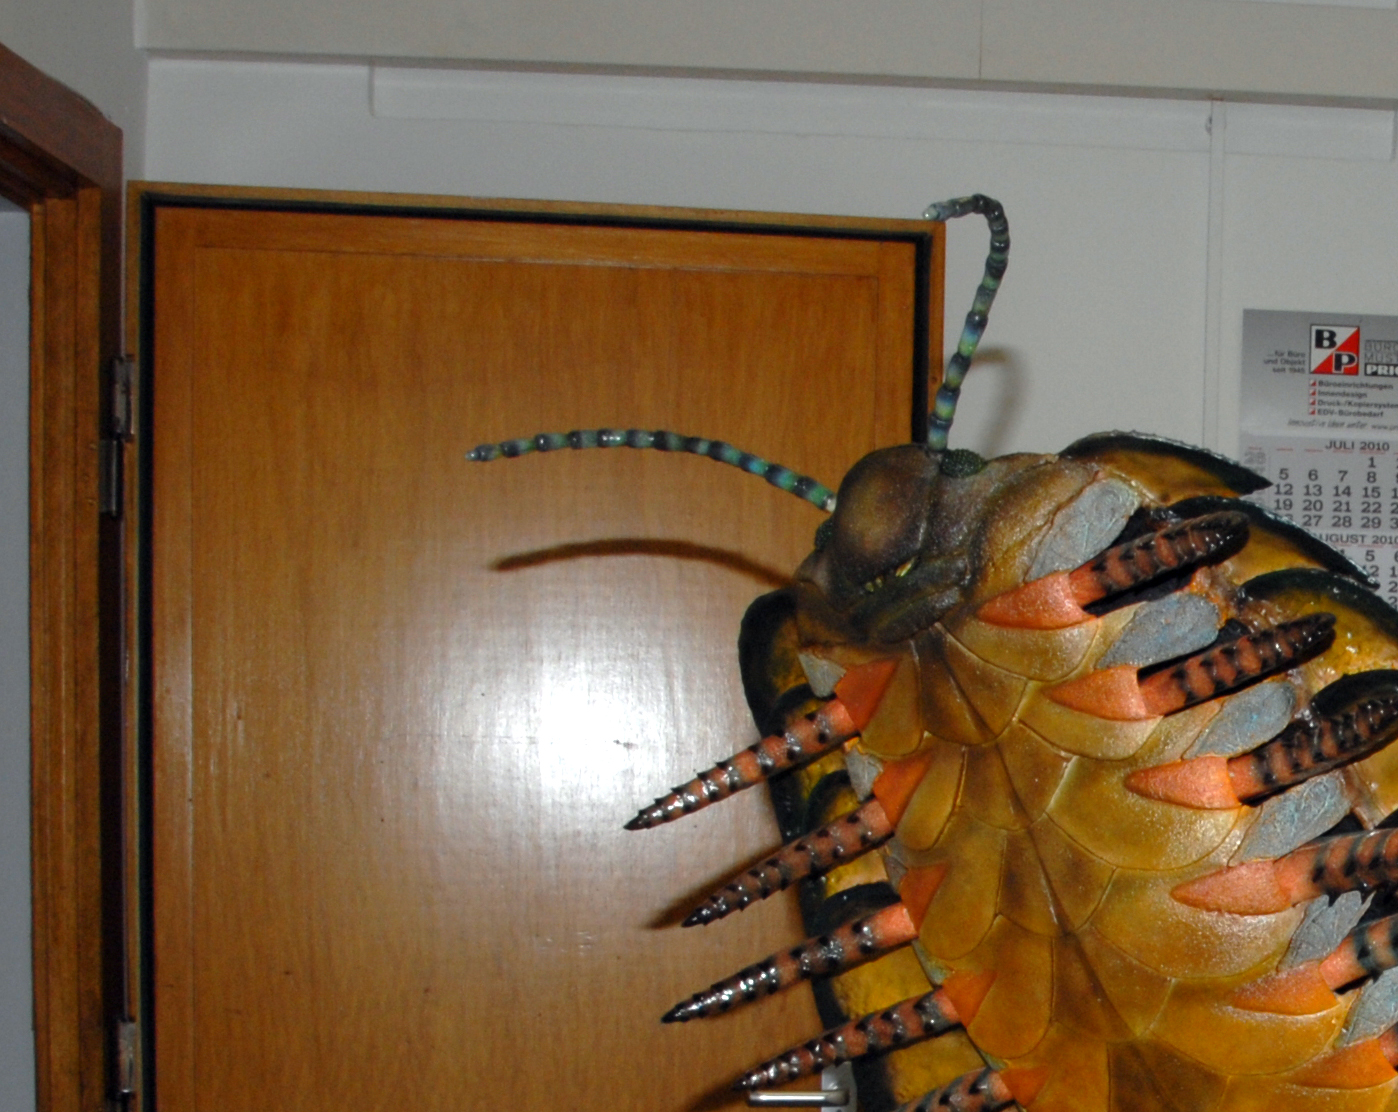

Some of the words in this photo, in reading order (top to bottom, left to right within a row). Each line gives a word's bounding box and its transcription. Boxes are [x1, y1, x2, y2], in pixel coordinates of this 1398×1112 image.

[1315, 329, 1337, 349] B
[1333, 352, 1357, 373] P
[1280, 358, 1306, 366] Objekt
[1318, 380, 1394, 391] Büroeinrichtungen
[1318, 390, 1368, 399] Innendesign
[1325, 440, 1355, 450] JULI
[1360, 441, 1390, 451] 2010
[1368, 457, 1376, 468] 1
[1279, 468, 1289, 480] 5
[1308, 469, 1318, 482] 6
[1338, 470, 1348, 482] 7
[1367, 472, 1377, 483] 8
[1275, 484, 1293, 495] 12
[1304, 484, 1322, 496] 13
[1333, 485, 1352, 497] 14
[1362, 487, 1381, 499] 15
[1274, 498, 1293, 510] 19
[1303, 500, 1323, 511] 20
[1333, 501, 1352, 512] 21
[1361, 502, 1382, 514] 22
[1302, 514, 1323, 527] 27
[1332, 516, 1352, 527] 28
[1360, 516, 1381, 529] 29
[1318, 533, 1366, 545] UGUST
[1365, 550, 1375, 562] 5
[1362, 565, 1379, 577] 2
